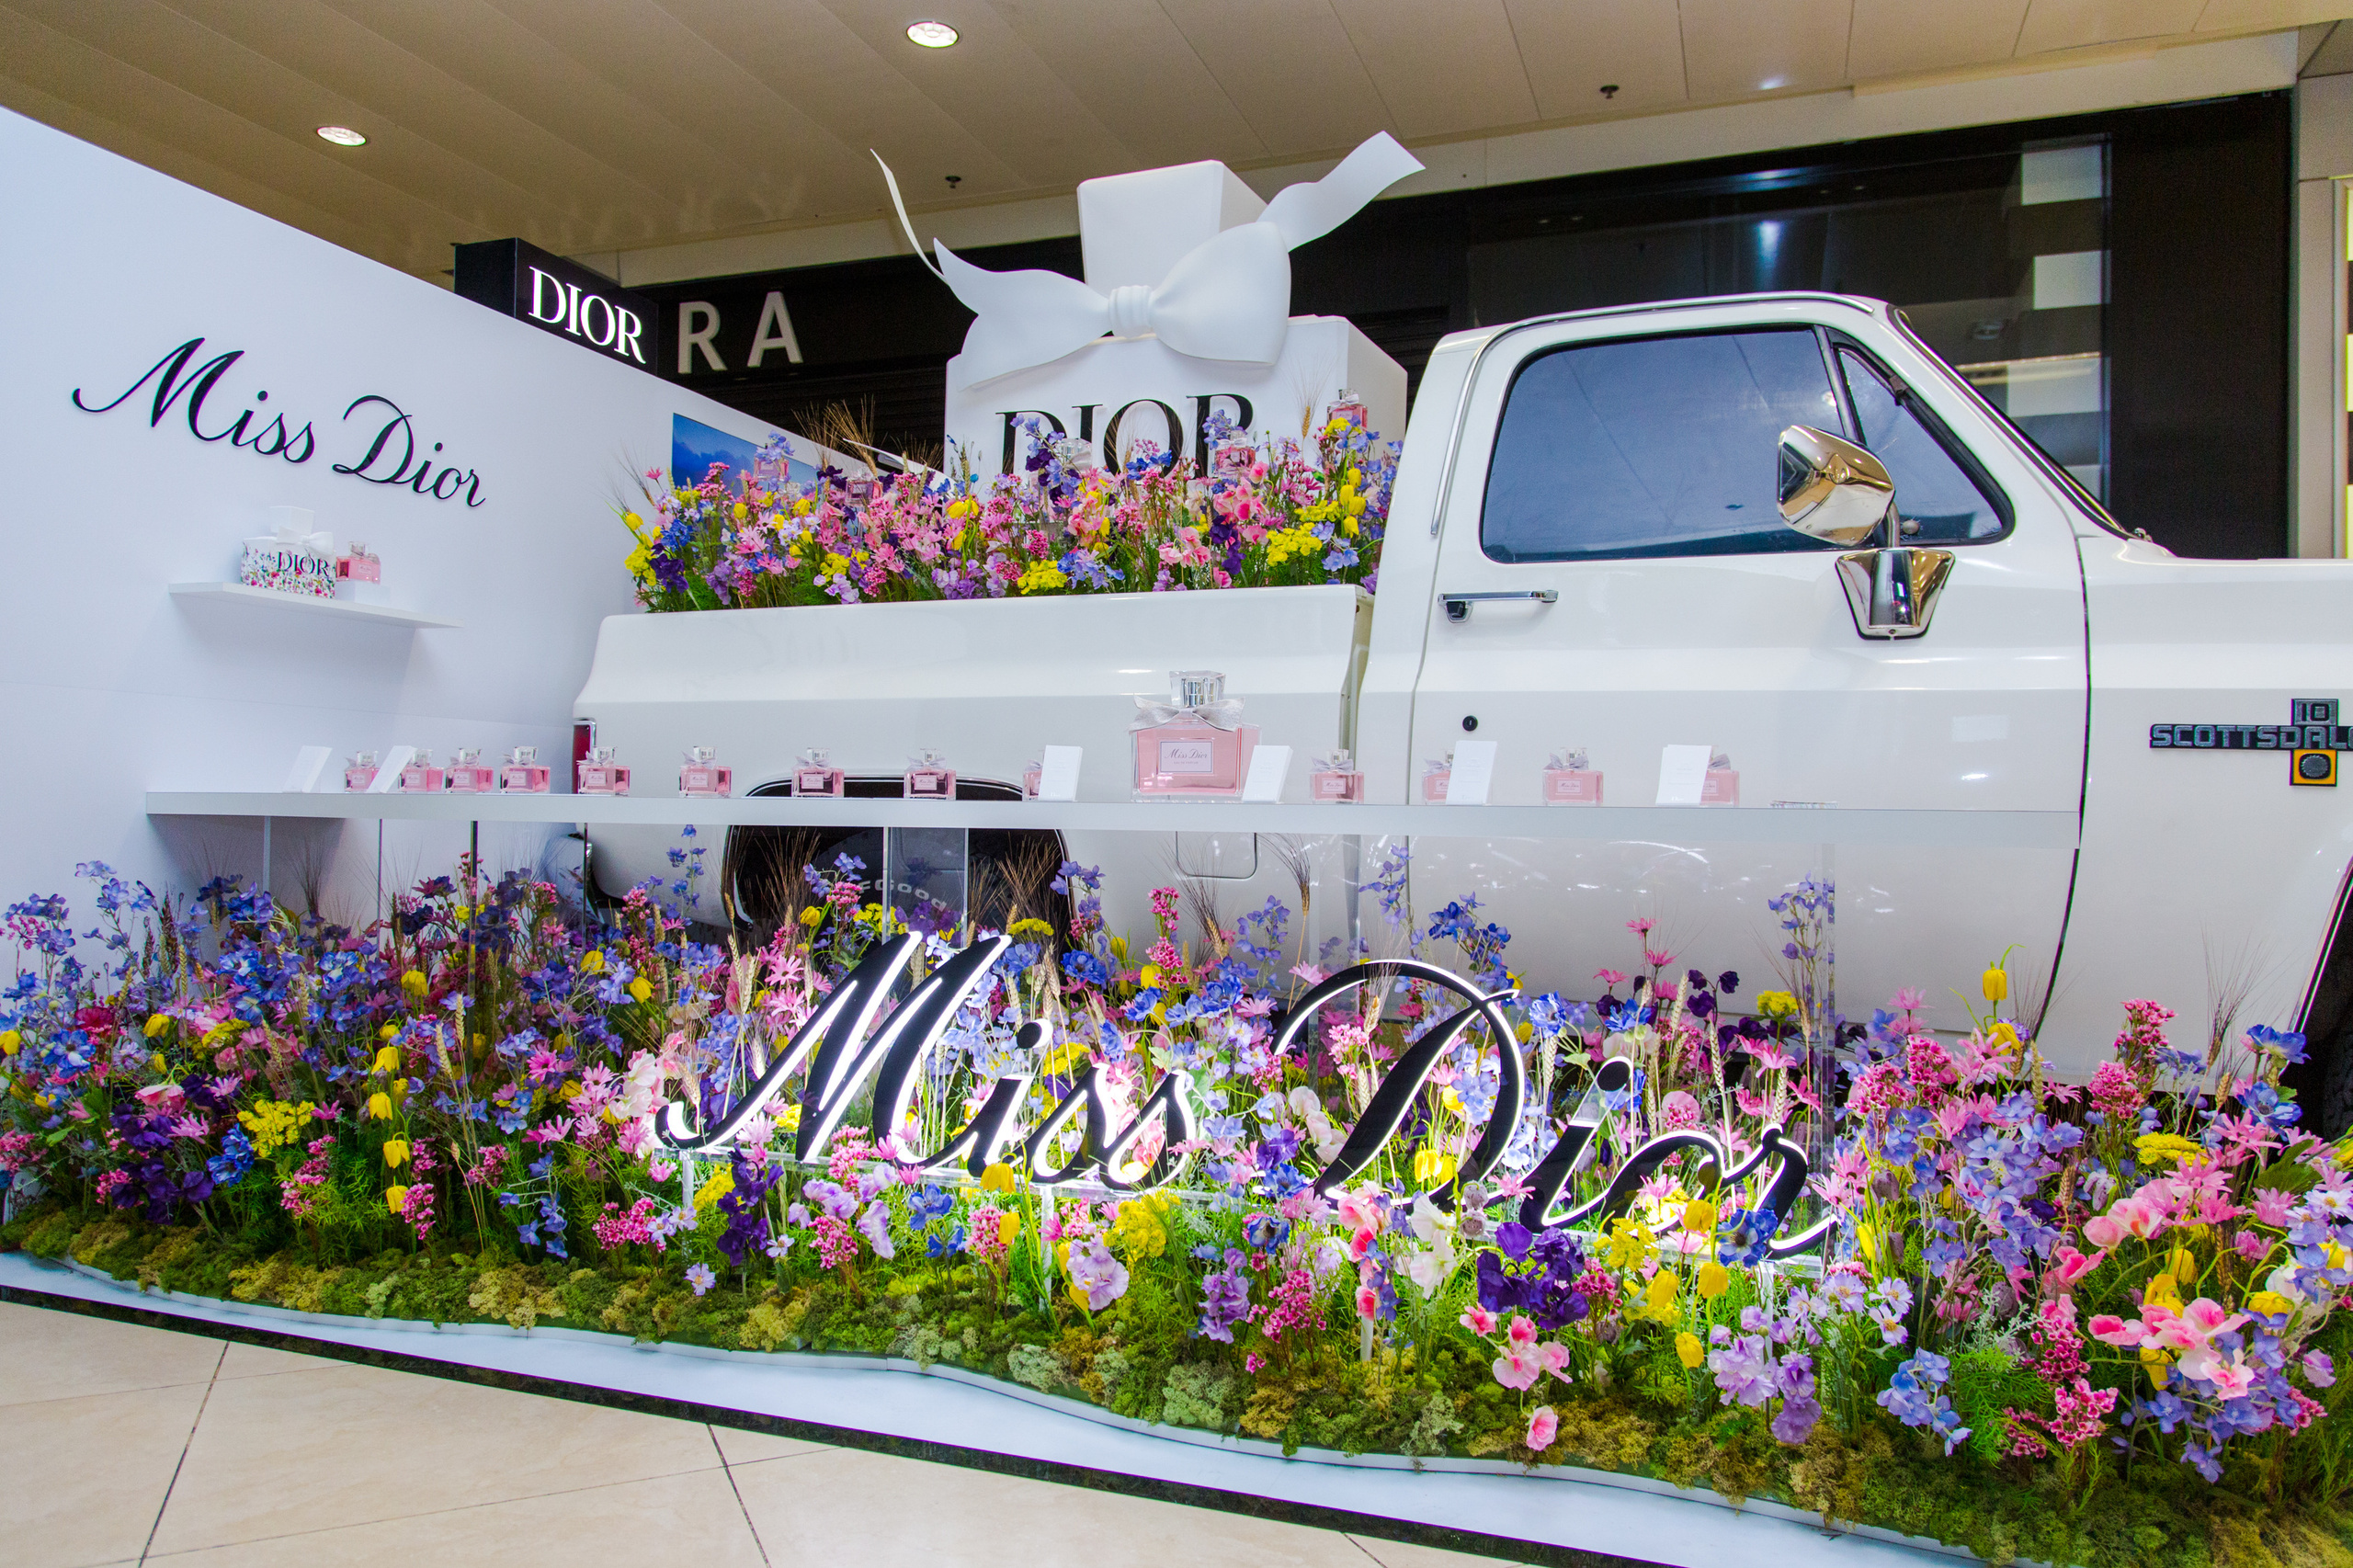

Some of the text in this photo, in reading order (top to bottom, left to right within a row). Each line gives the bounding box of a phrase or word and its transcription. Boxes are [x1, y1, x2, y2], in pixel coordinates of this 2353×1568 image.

[528, 265, 647, 365] DIOR
[72, 336, 486, 508] Miss Dior
[995, 392, 1254, 482] DIOR
[278, 551, 330, 577] DIOR
[1165, 748, 1208, 759] Miss Dior
[655, 930, 1838, 1260] Miss Dior
